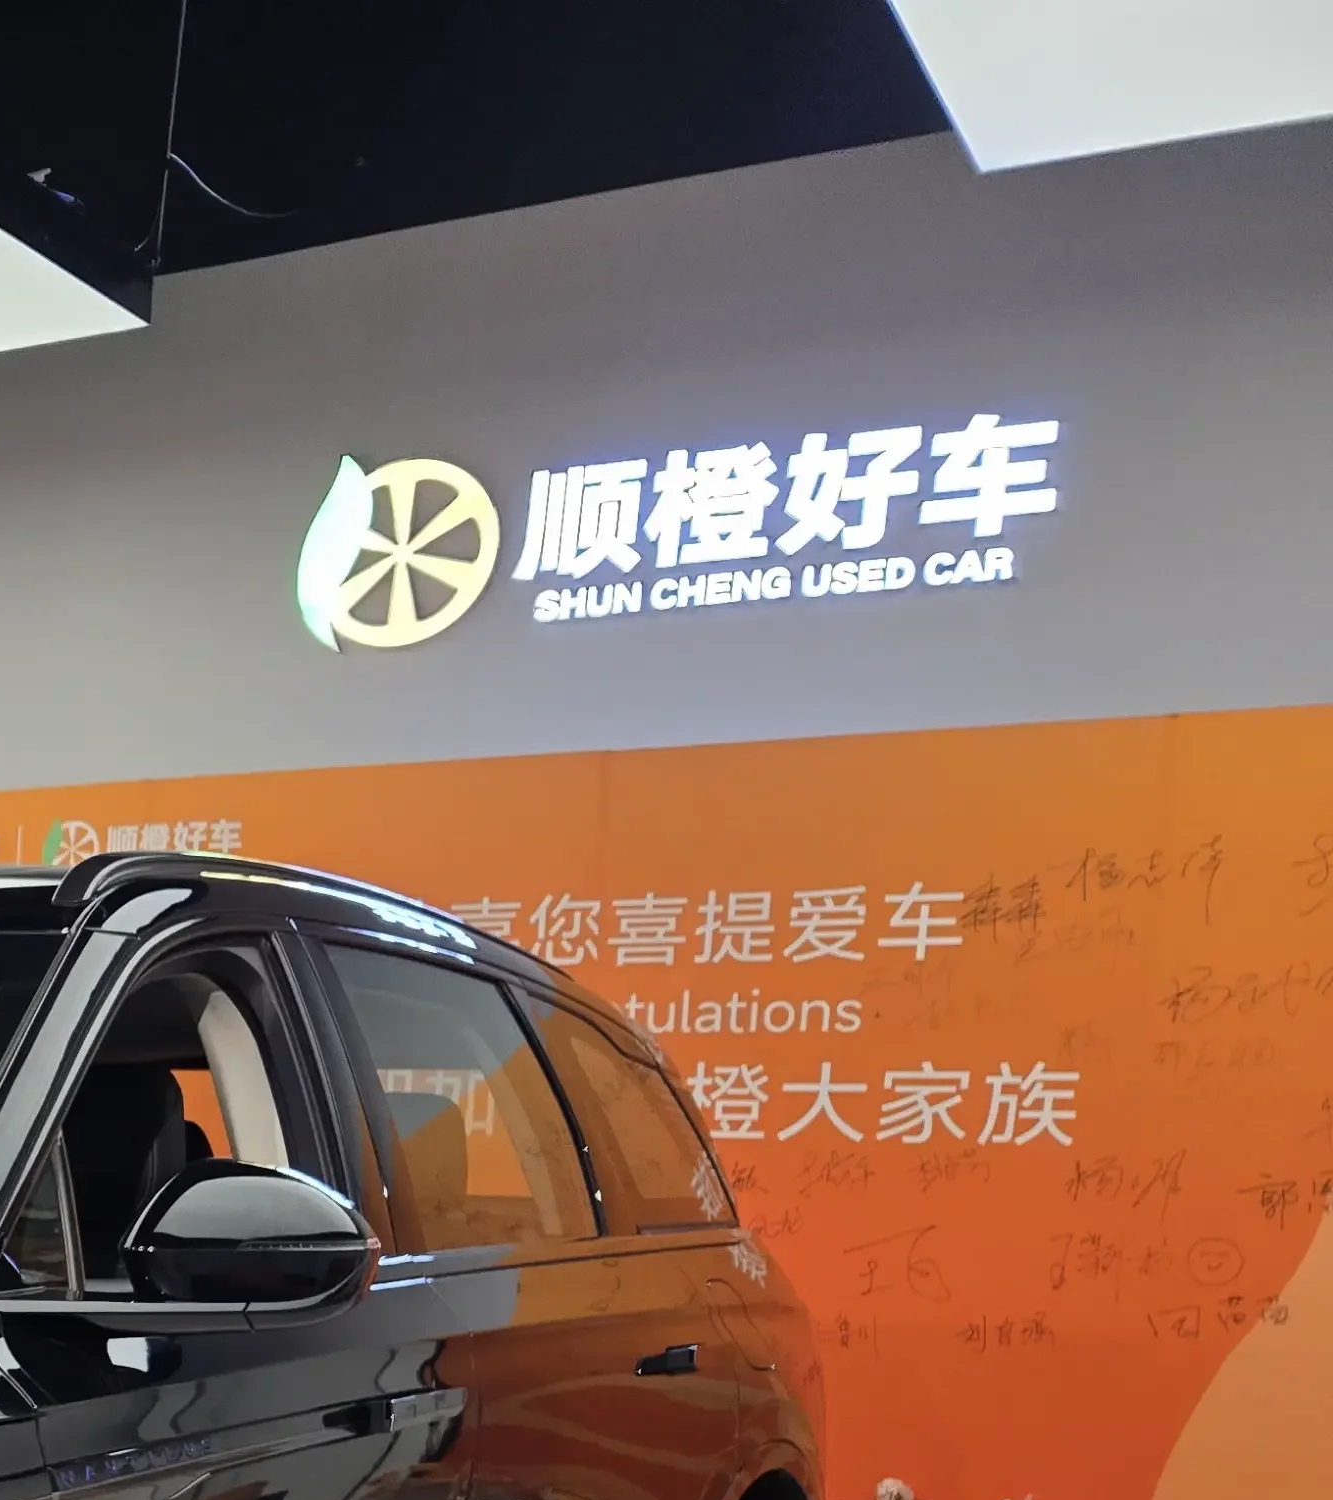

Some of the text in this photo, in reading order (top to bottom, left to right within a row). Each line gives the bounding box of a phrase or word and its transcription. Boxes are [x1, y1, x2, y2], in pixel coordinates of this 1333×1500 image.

[513, 414, 1059, 580] 顺橙好车
[533, 547, 1014, 622] SHUN CHENG USED CAR
[106, 818, 242, 854] 顺橙好车
[625, 987, 863, 1034] tulations
[686, 1061, 1080, 1147] 橙大家族
